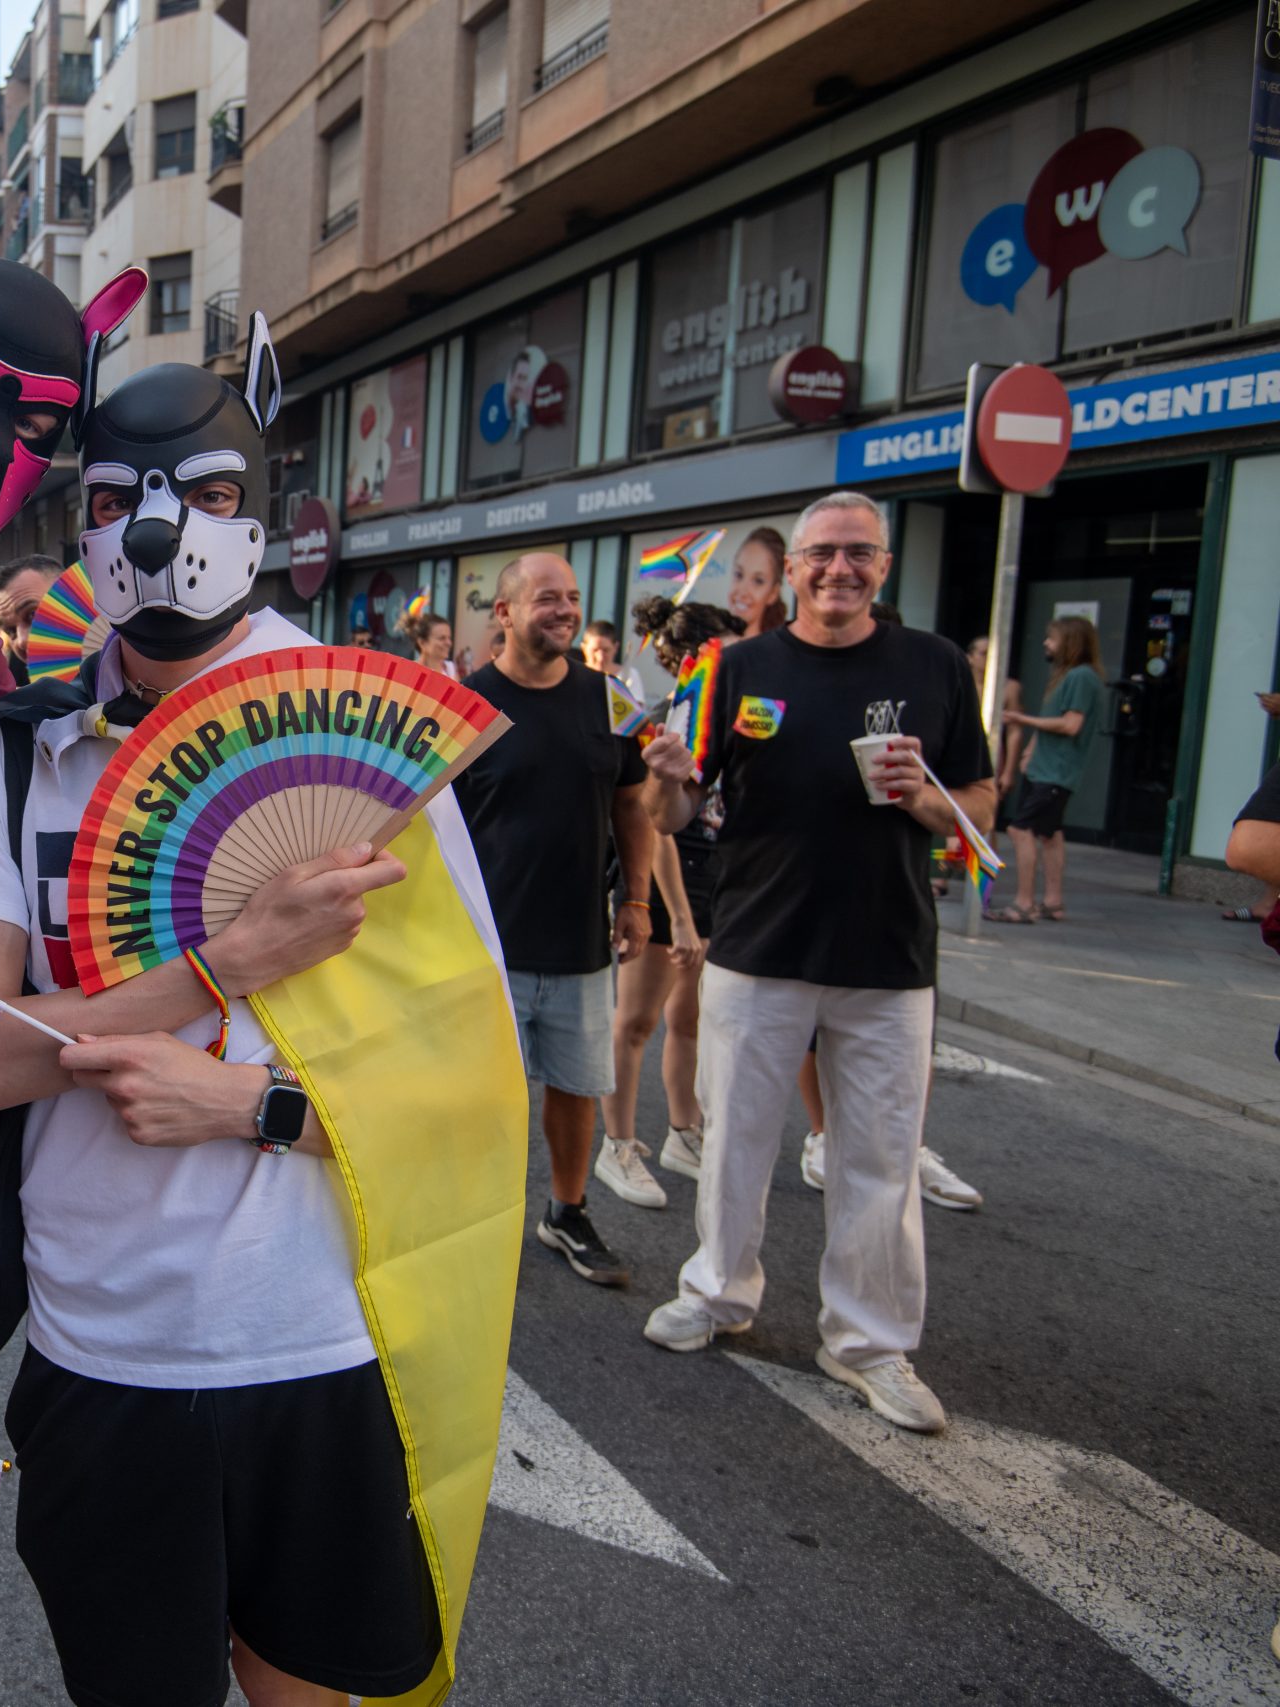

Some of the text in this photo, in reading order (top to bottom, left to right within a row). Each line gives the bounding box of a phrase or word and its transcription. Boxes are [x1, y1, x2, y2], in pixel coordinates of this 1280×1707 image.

[985, 239, 1015, 277] e
[1054, 180, 1106, 227] w
[661, 266, 808, 353] english
[657, 351, 720, 389] world
[787, 370, 843, 389] english
[863, 369, 1280, 468] ENGLIS LDCENTER
[407, 516, 463, 542] FRANÇAIS
[486, 500, 547, 529] DEUTSCH
[576, 480, 656, 514] ESPAÑOL
[106, 688, 441, 958] NEVER STOP DANCING
